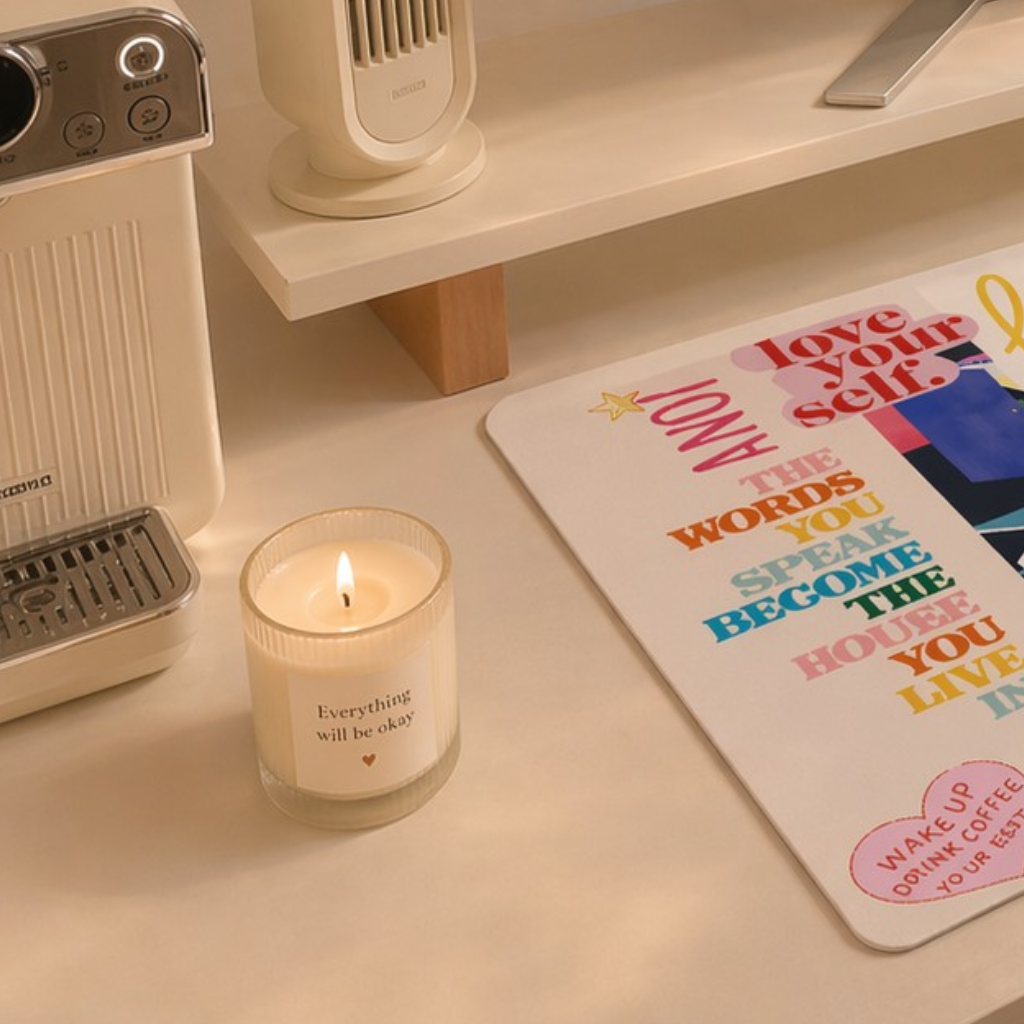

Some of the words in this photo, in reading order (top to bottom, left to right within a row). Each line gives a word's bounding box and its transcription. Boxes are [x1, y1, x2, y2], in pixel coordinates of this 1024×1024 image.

[754, 309, 906, 370] love
[803, 316, 963, 390] your
[792, 359, 946, 428] self.
[738, 447, 842, 495] THE
[667, 469, 866, 552] WORDS
[775, 490, 886, 545] YOU
[730, 516, 910, 598] SPEAK
[702, 540, 933, 643] BECOME
[843, 565, 956, 620] THE
[887, 615, 1006, 677] YOU
[316, 689, 412, 720] Everything
[316, 727, 347, 742] will
[353, 726, 374, 740] be
[377, 710, 415, 735] okay
[876, 816, 956, 872] WAKE
[943, 782, 974, 813] UP
[961, 777, 1024, 843] COFFEE
